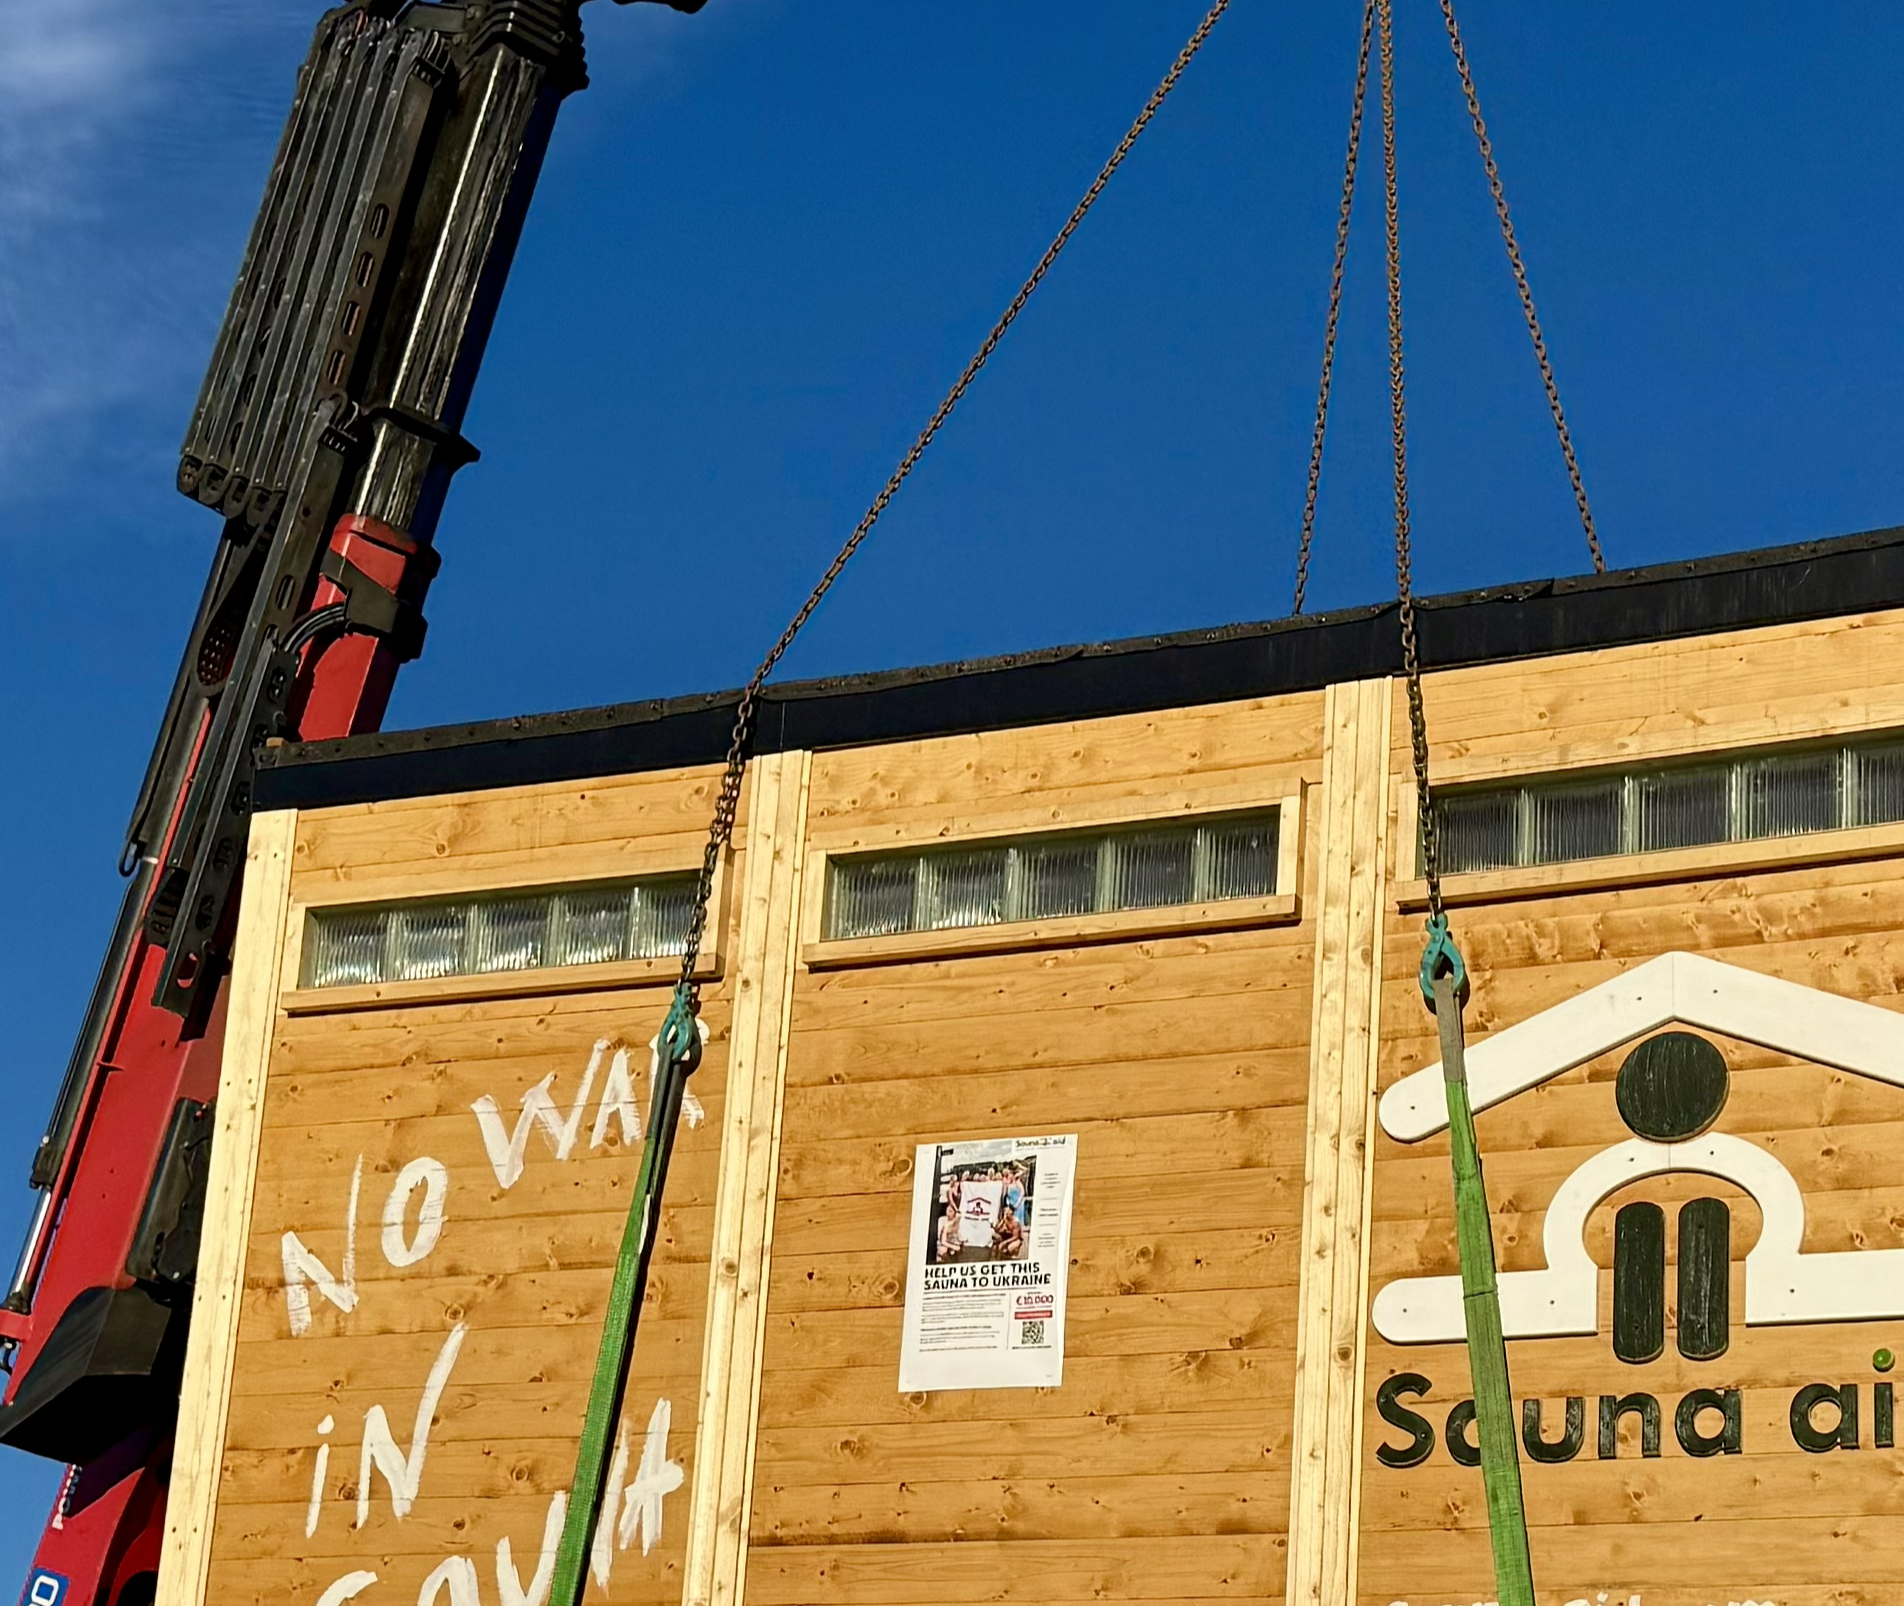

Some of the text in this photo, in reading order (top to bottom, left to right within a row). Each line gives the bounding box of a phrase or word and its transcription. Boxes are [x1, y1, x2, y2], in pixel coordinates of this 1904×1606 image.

[281, 1154, 449, 1337] NO
[925, 1262, 1040, 1279] HELP US GET THIS
[924, 1273, 1052, 1290] SAUNA TO UKRAINE
